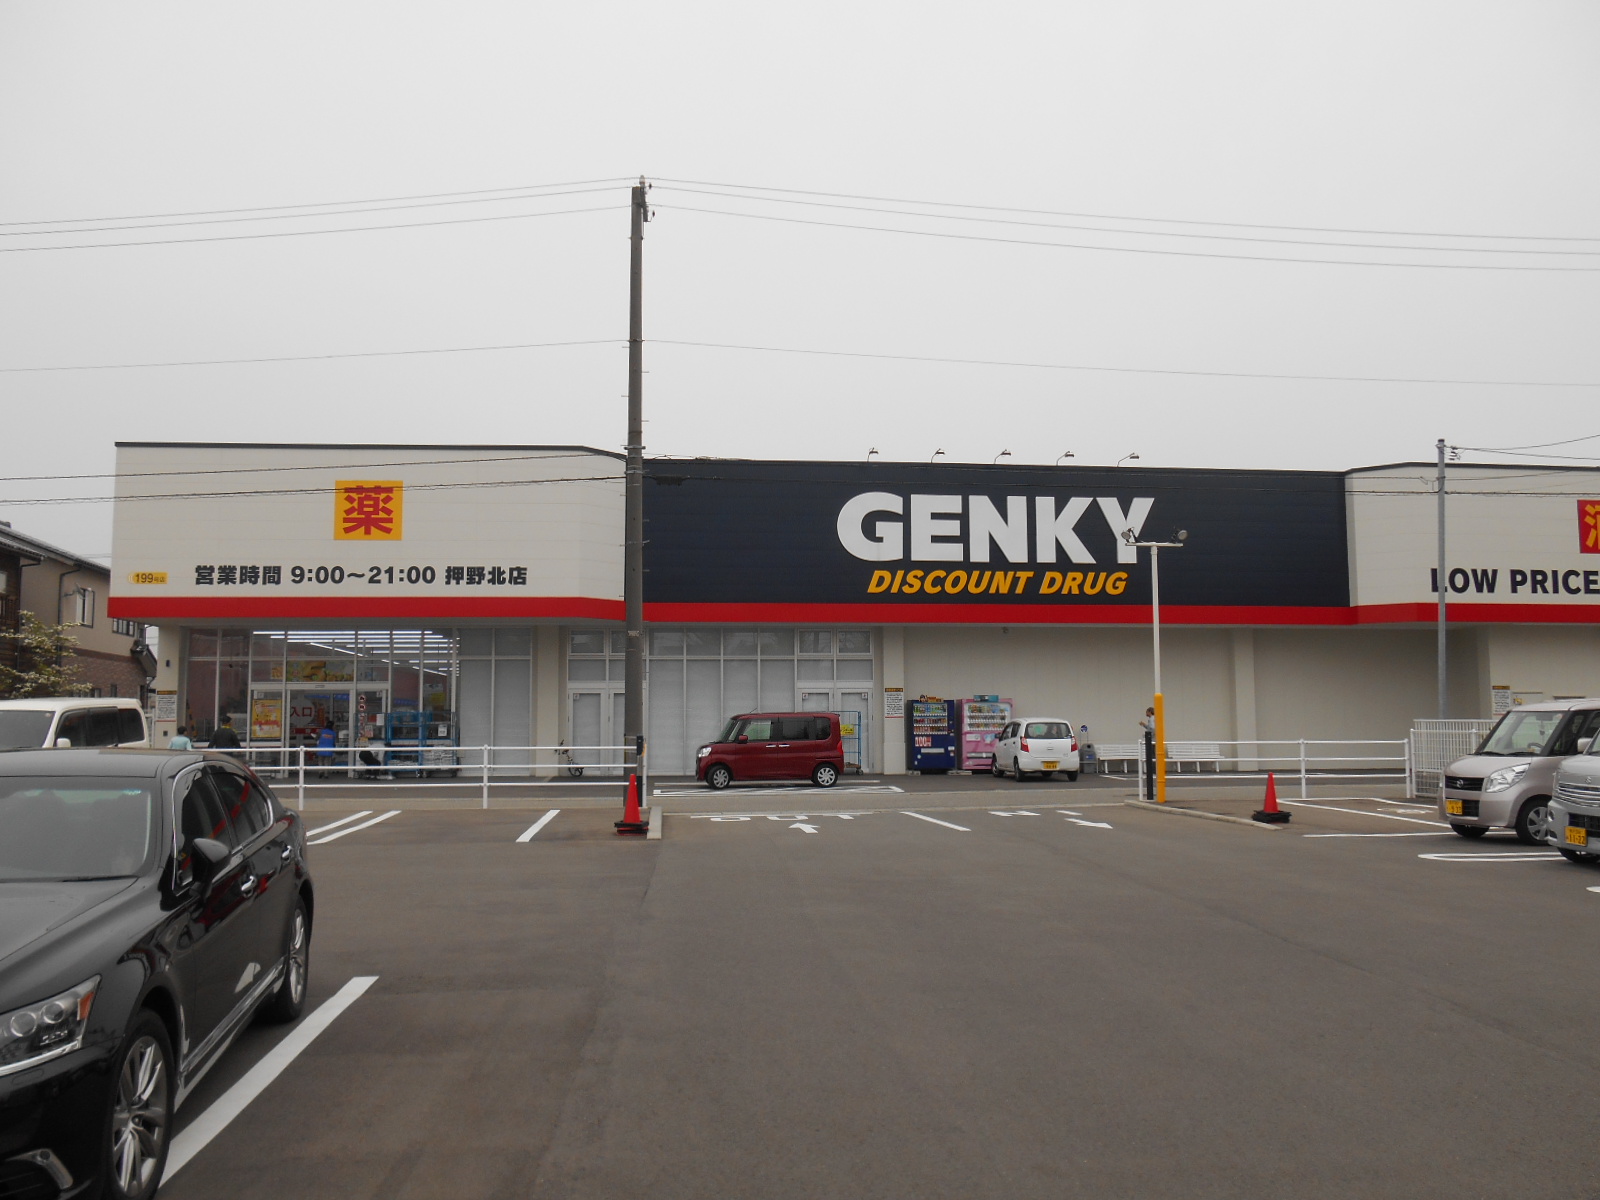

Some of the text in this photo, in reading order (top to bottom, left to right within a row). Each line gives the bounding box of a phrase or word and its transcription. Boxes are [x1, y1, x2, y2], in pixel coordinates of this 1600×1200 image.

[343, 485, 394, 535] 薬
[836, 491, 1155, 564] GENKY
[195, 565, 282, 585] 営業時間
[445, 566, 527, 586] 押野北店
[867, 570, 1129, 596] DISCOUNT DRUG
[1430, 568, 1600, 595] LOW PRICE
[290, 706, 313, 718] 入口
